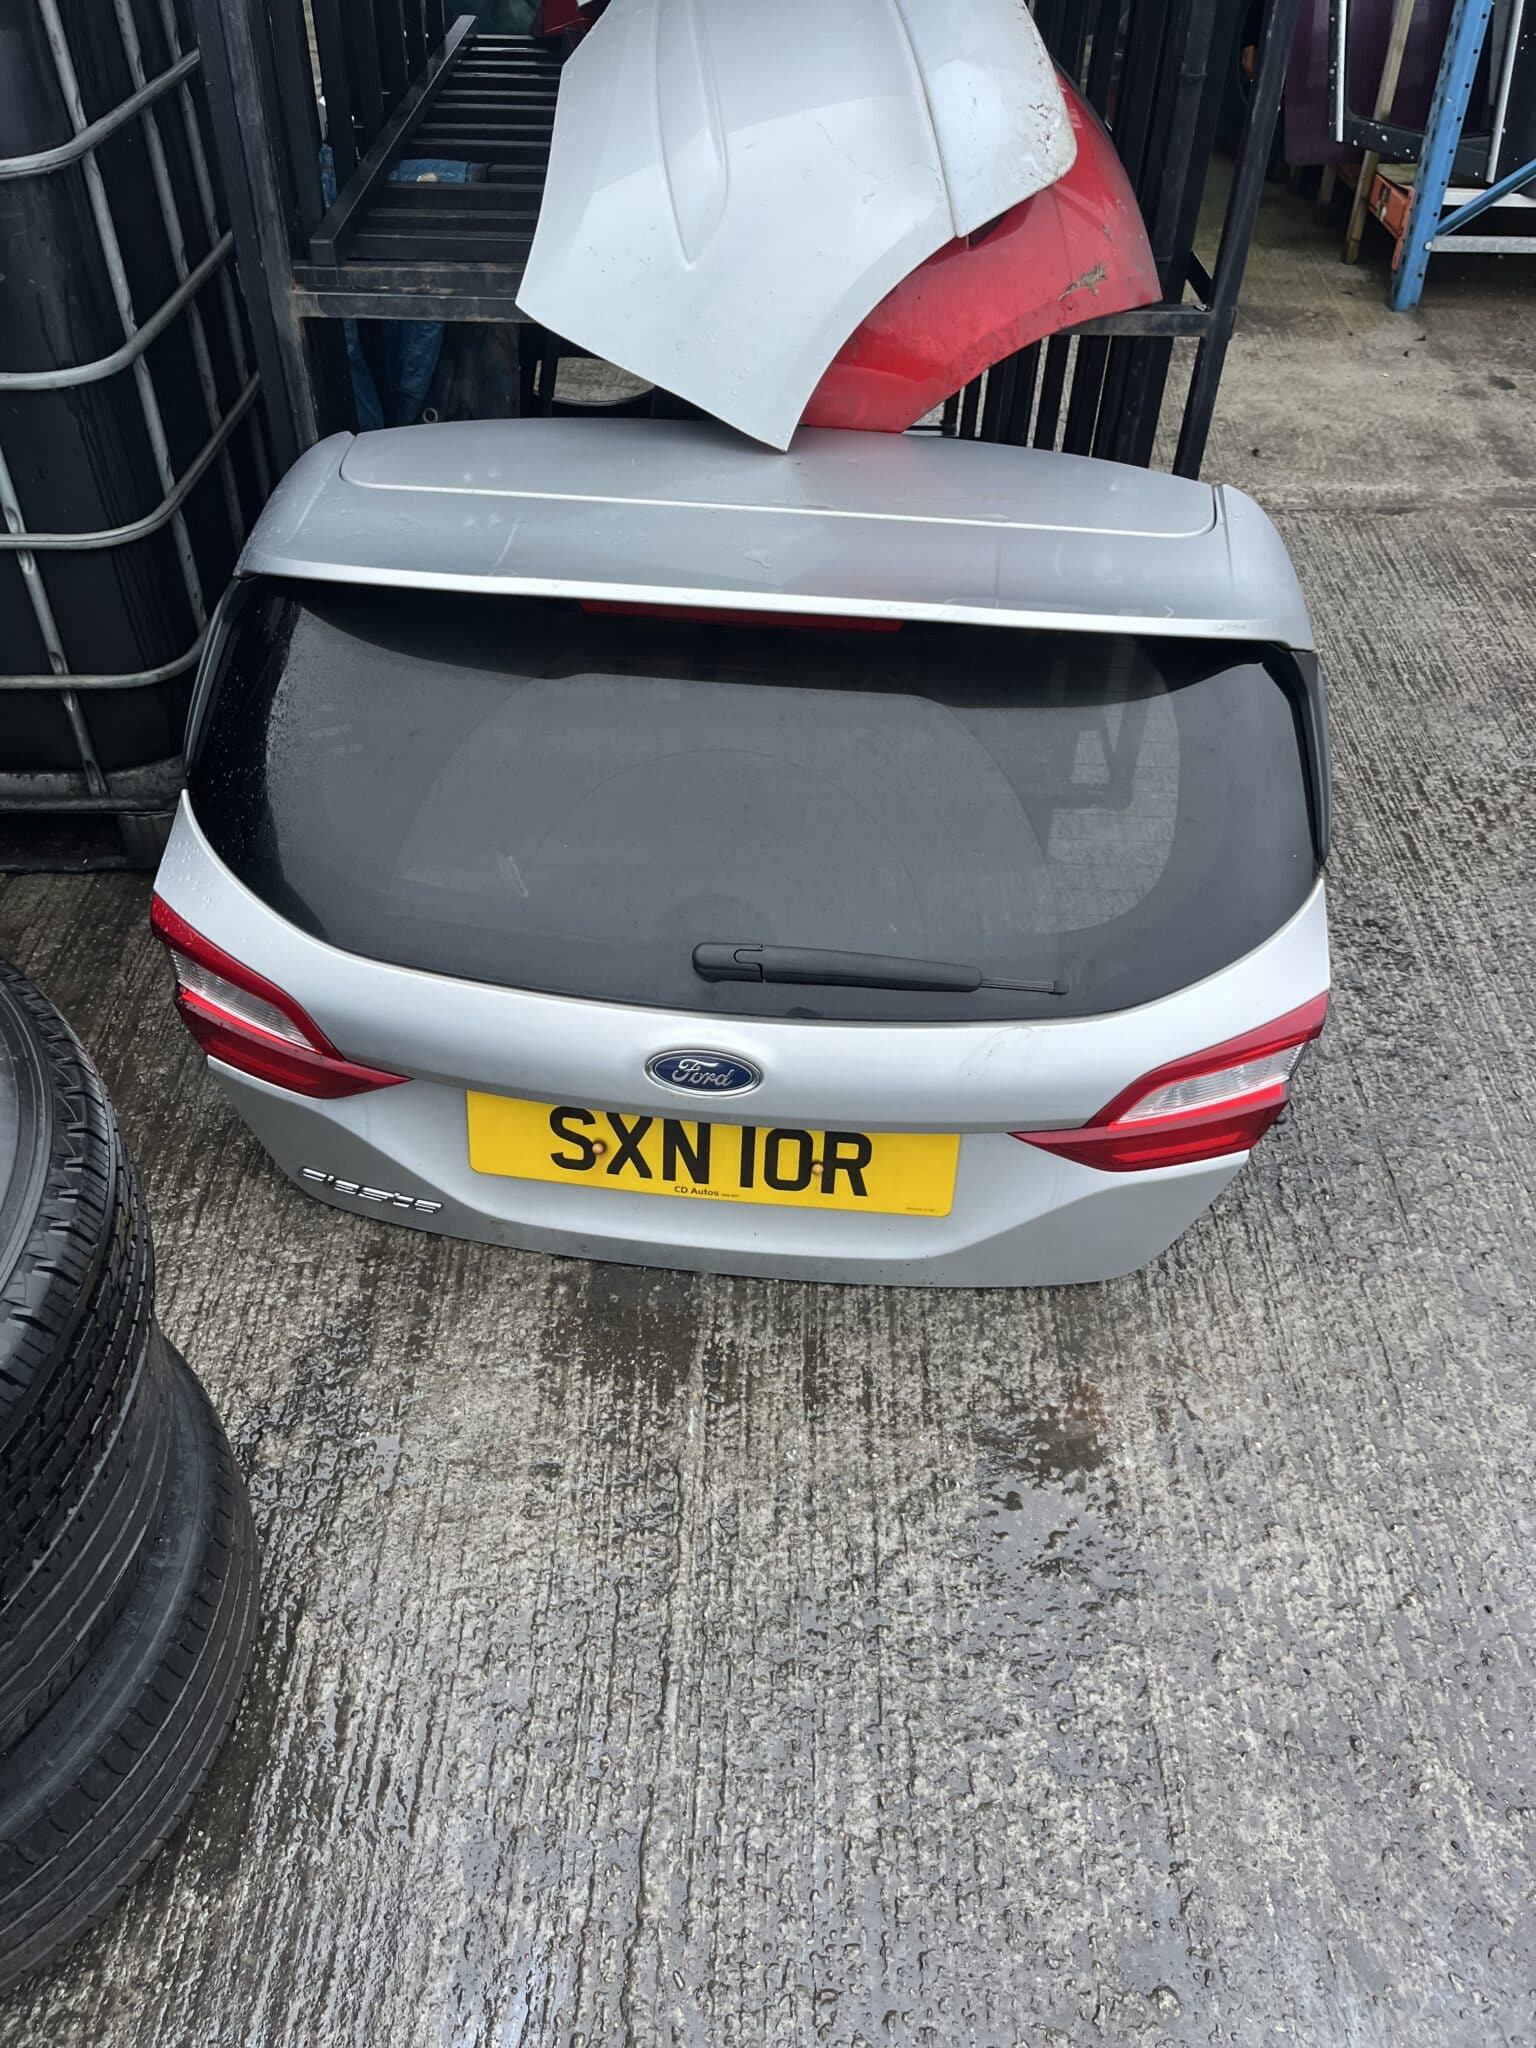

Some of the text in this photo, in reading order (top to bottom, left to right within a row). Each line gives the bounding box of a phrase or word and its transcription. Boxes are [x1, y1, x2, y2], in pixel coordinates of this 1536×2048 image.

[672, 1058, 735, 1086] Ford
[550, 1106, 711, 1185] SXN
[674, 1185, 688, 1194] CD
[690, 1187, 719, 1197] Autos
